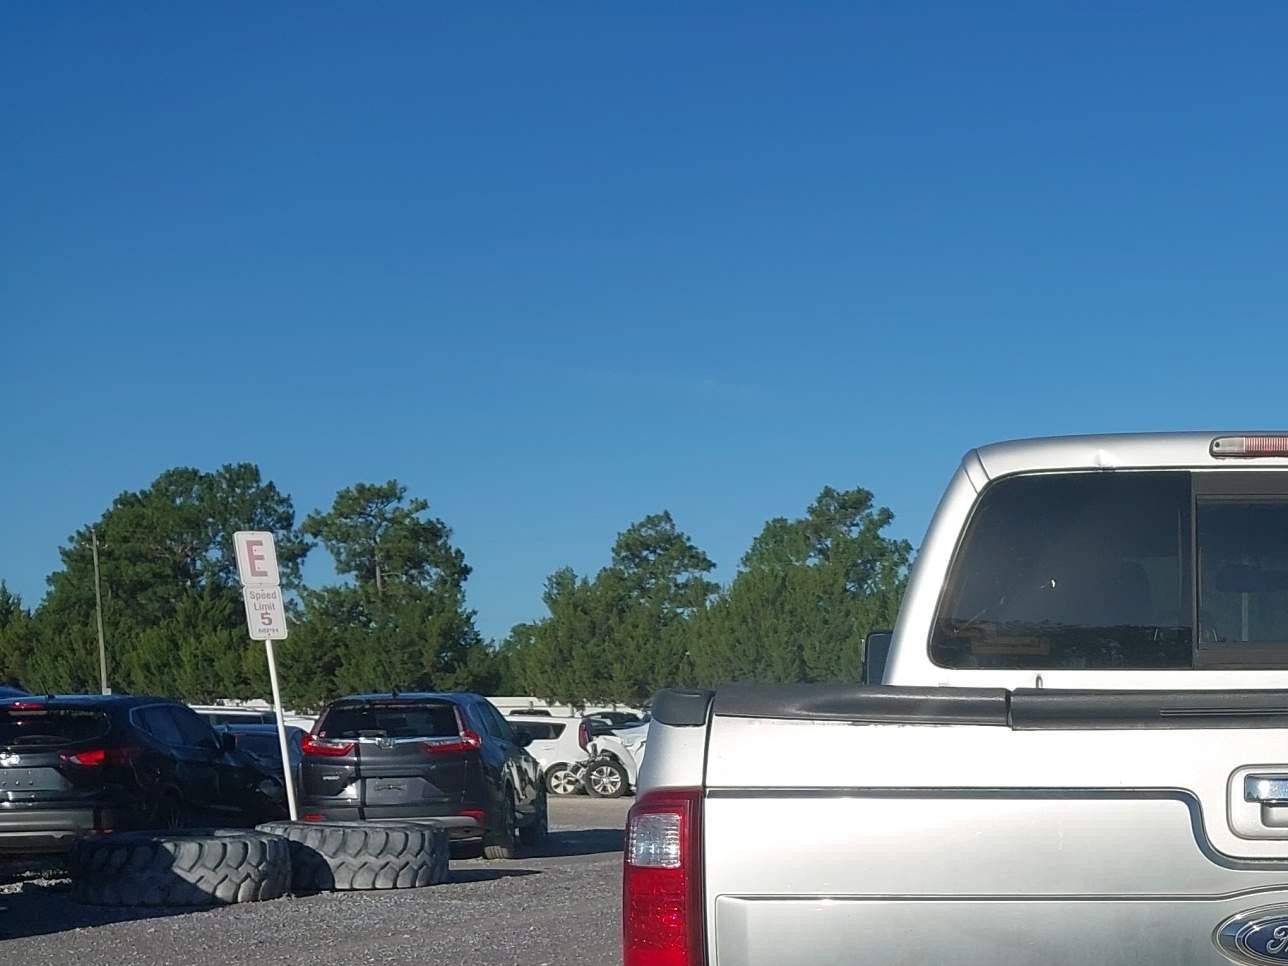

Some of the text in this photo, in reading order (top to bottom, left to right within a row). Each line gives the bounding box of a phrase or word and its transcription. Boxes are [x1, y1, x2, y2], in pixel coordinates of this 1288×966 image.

[246, 540, 268, 577] E
[249, 590, 277, 601] Speed
[253, 601, 276, 612] Limit
[260, 612, 273, 626] 5
